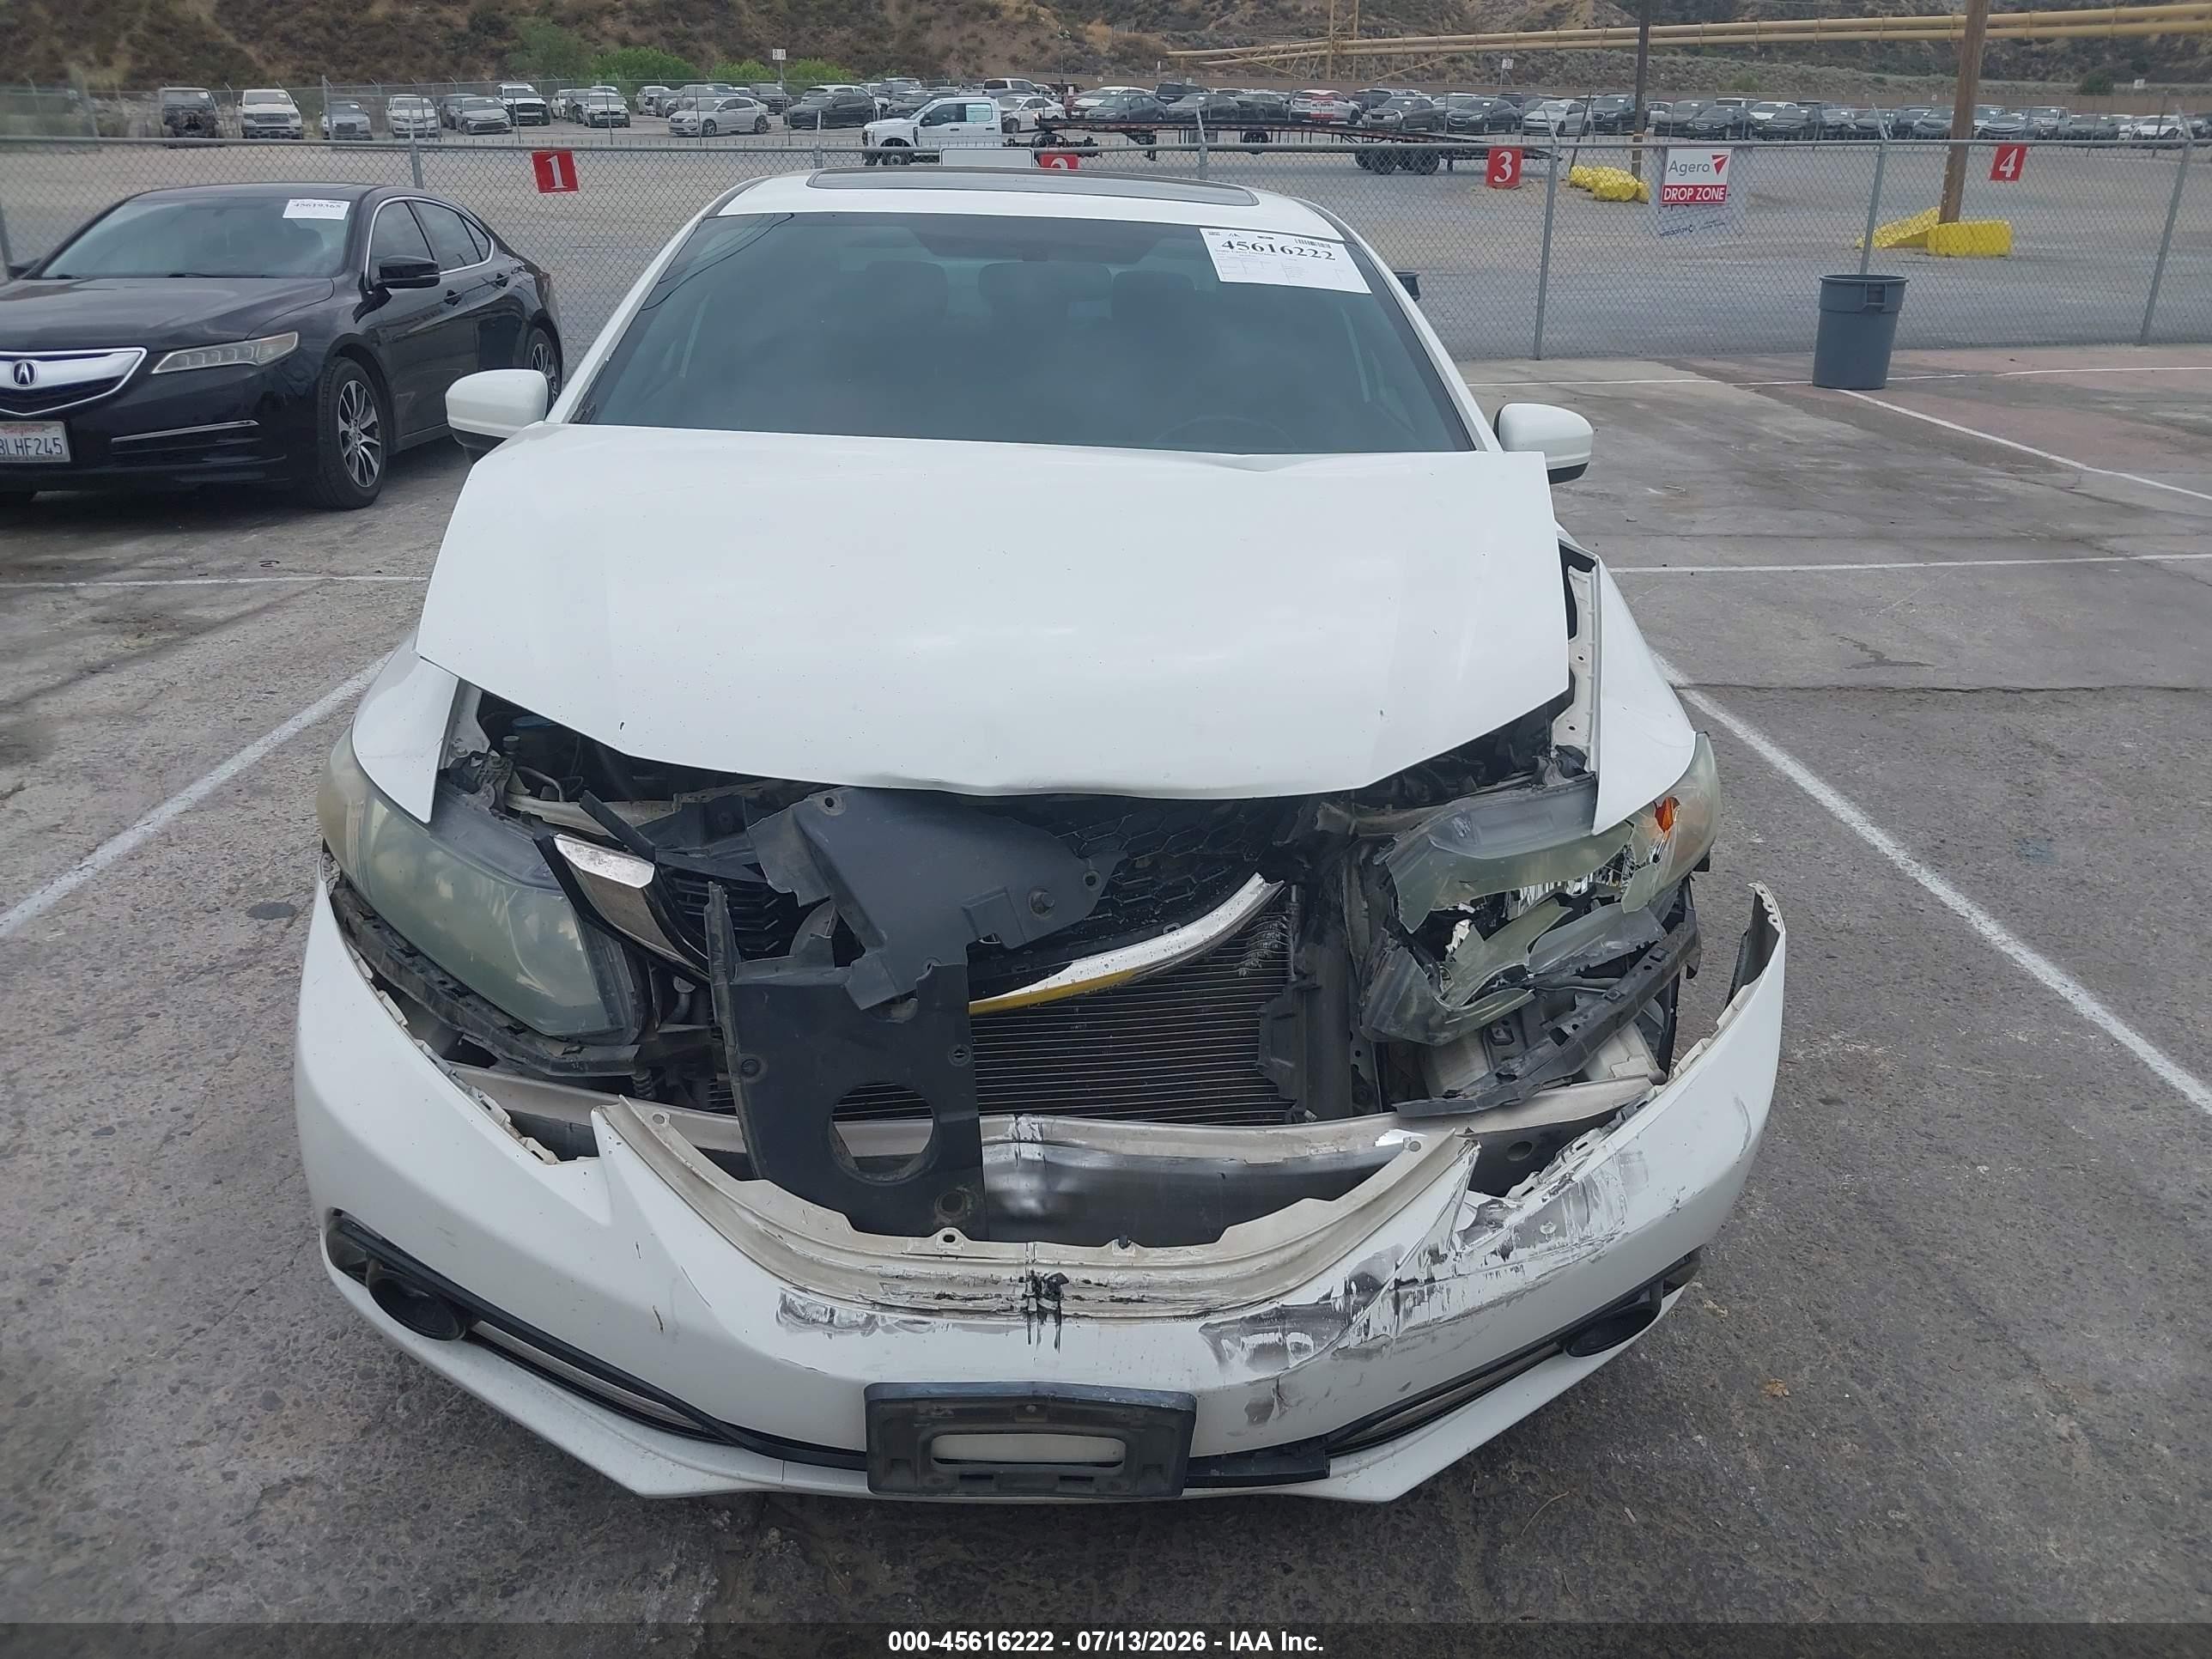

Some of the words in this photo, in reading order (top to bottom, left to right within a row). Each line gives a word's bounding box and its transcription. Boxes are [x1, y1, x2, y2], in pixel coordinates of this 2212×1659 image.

[545, 155, 568, 189] 1
[1494, 151, 1512, 182] 3
[1668, 161, 1711, 176] Agero
[1999, 148, 2018, 178] 4
[1663, 187, 1693, 201] DROP
[1696, 187, 1725, 201] ZONE
[1221, 240, 1336, 261] 45616222
